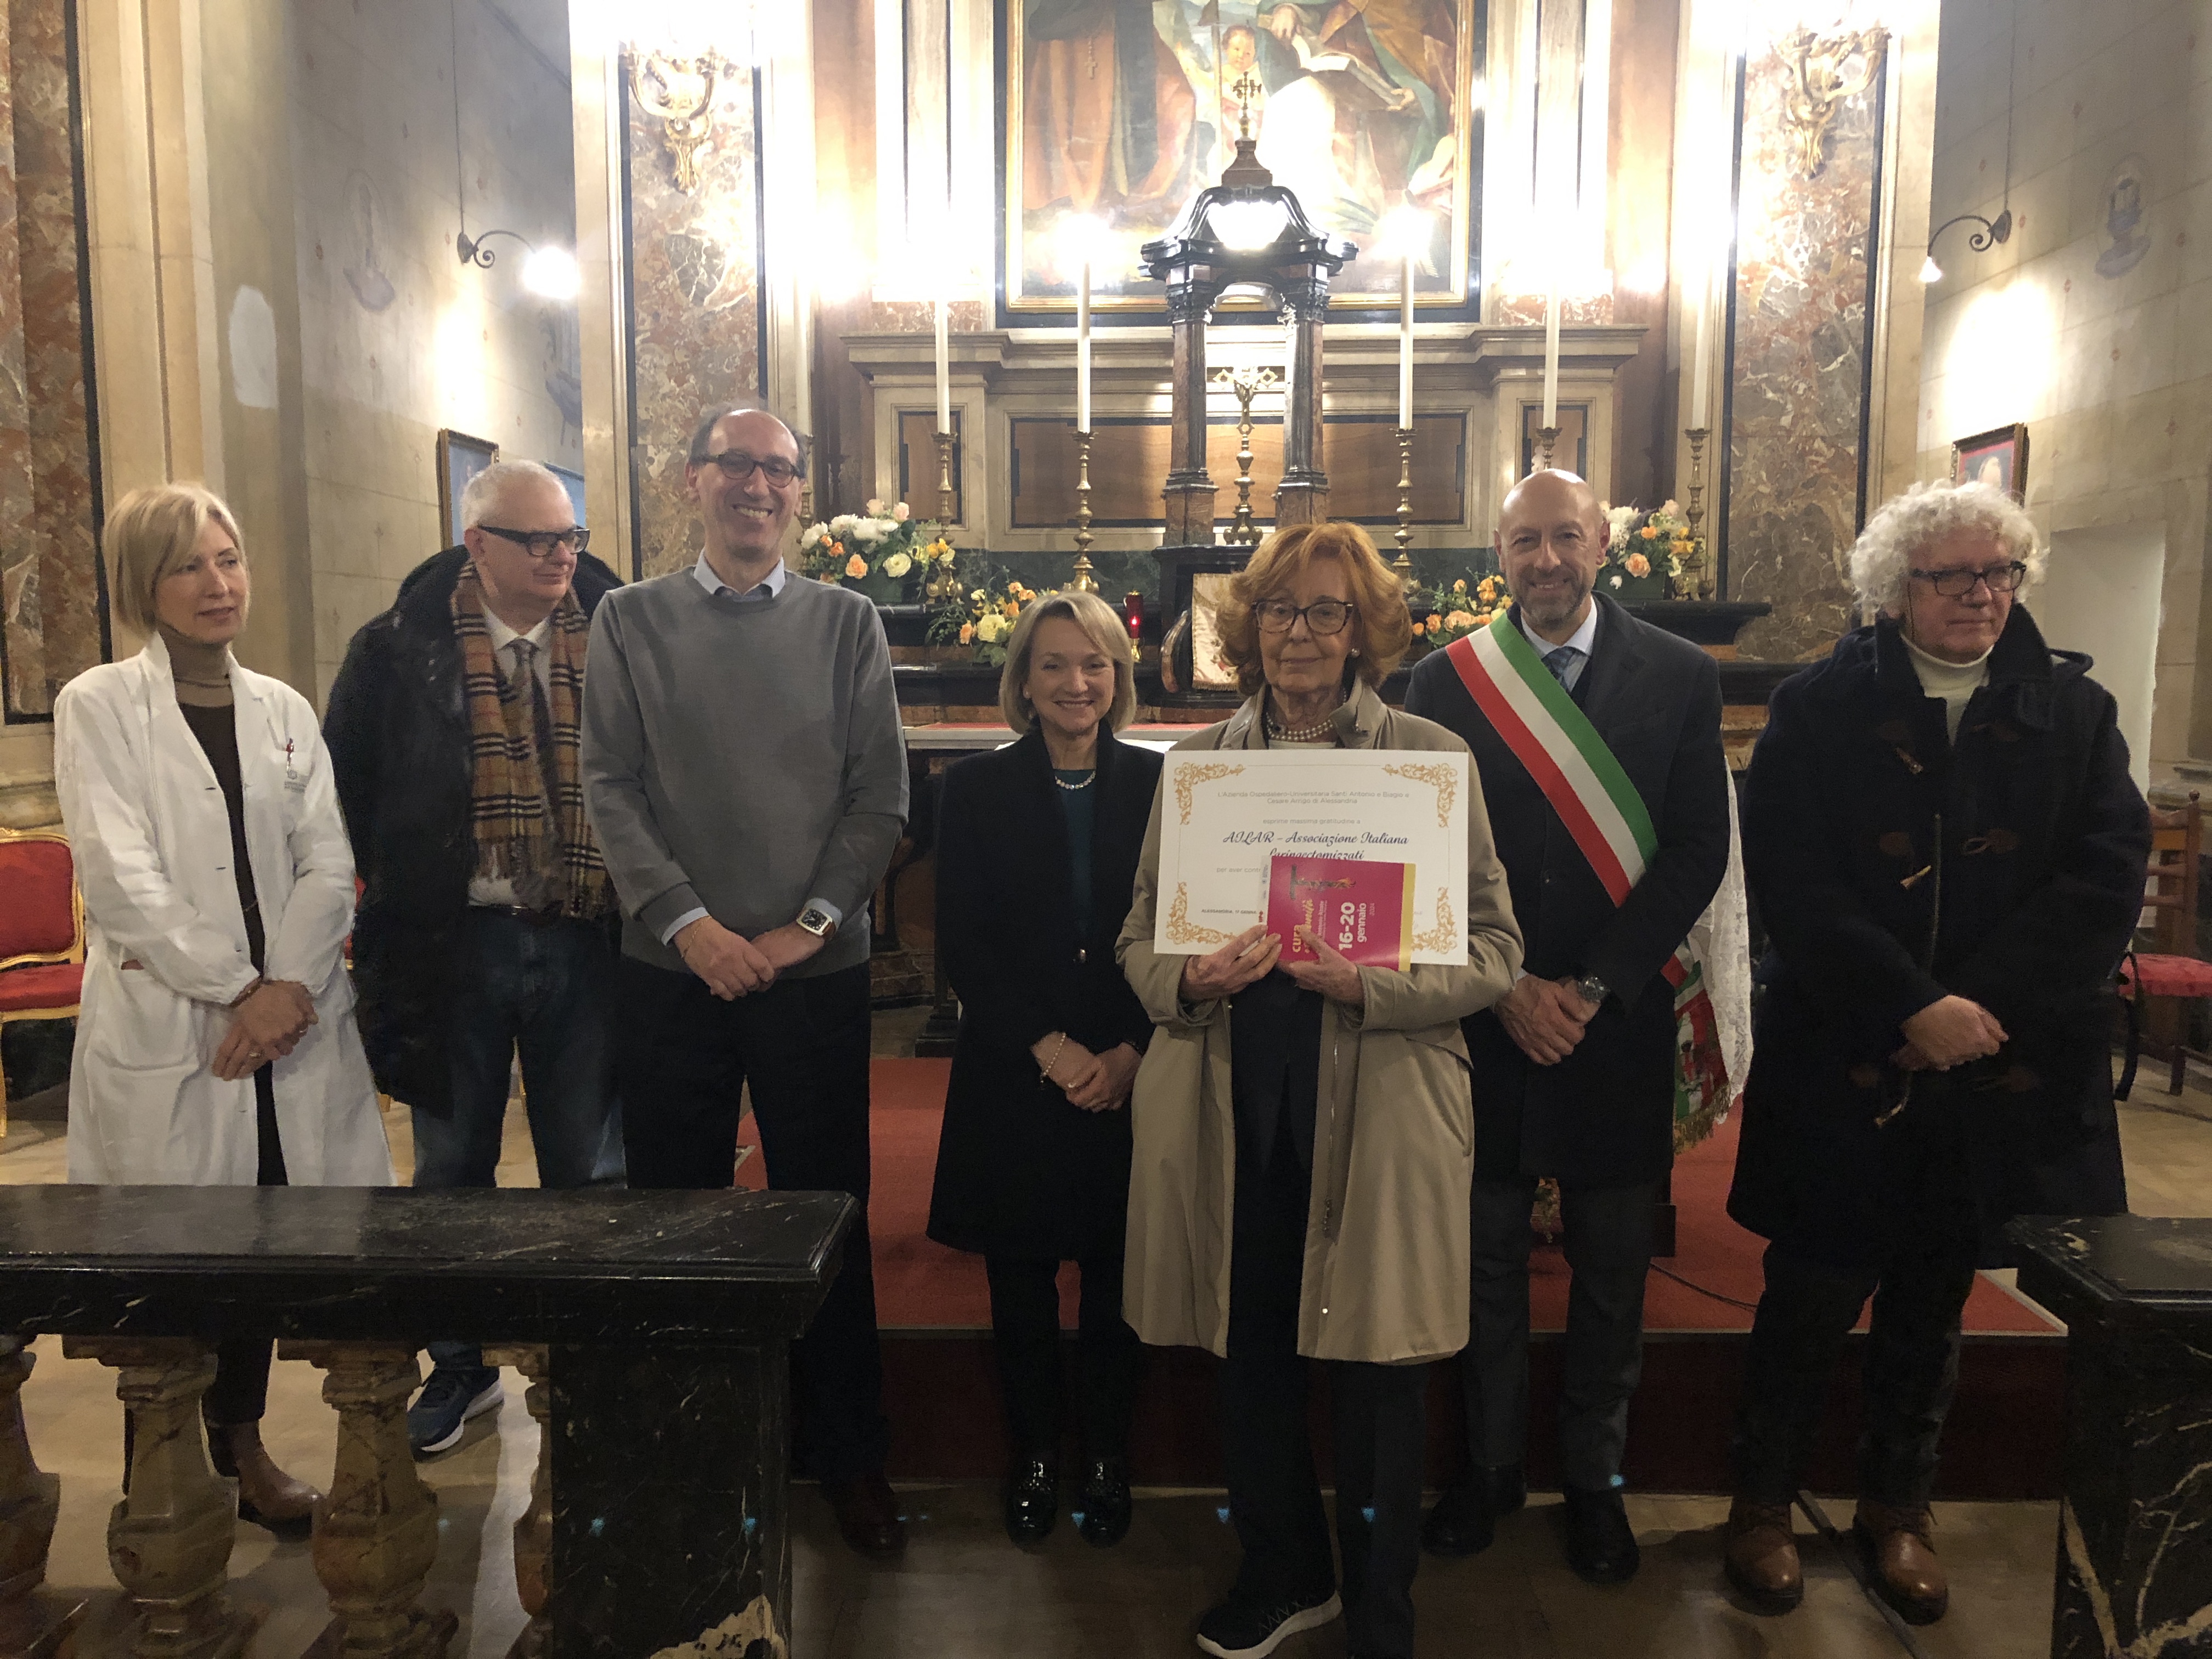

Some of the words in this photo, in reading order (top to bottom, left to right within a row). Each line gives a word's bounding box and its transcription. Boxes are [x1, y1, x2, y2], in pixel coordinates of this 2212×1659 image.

[1222, 831, 1275, 845] AILAR
[1285, 831, 1358, 847] Associazione
[1360, 832, 1409, 845] Italiana
[1338, 901, 1356, 952] 16-20
[1357, 902, 1367, 943] gennaio
